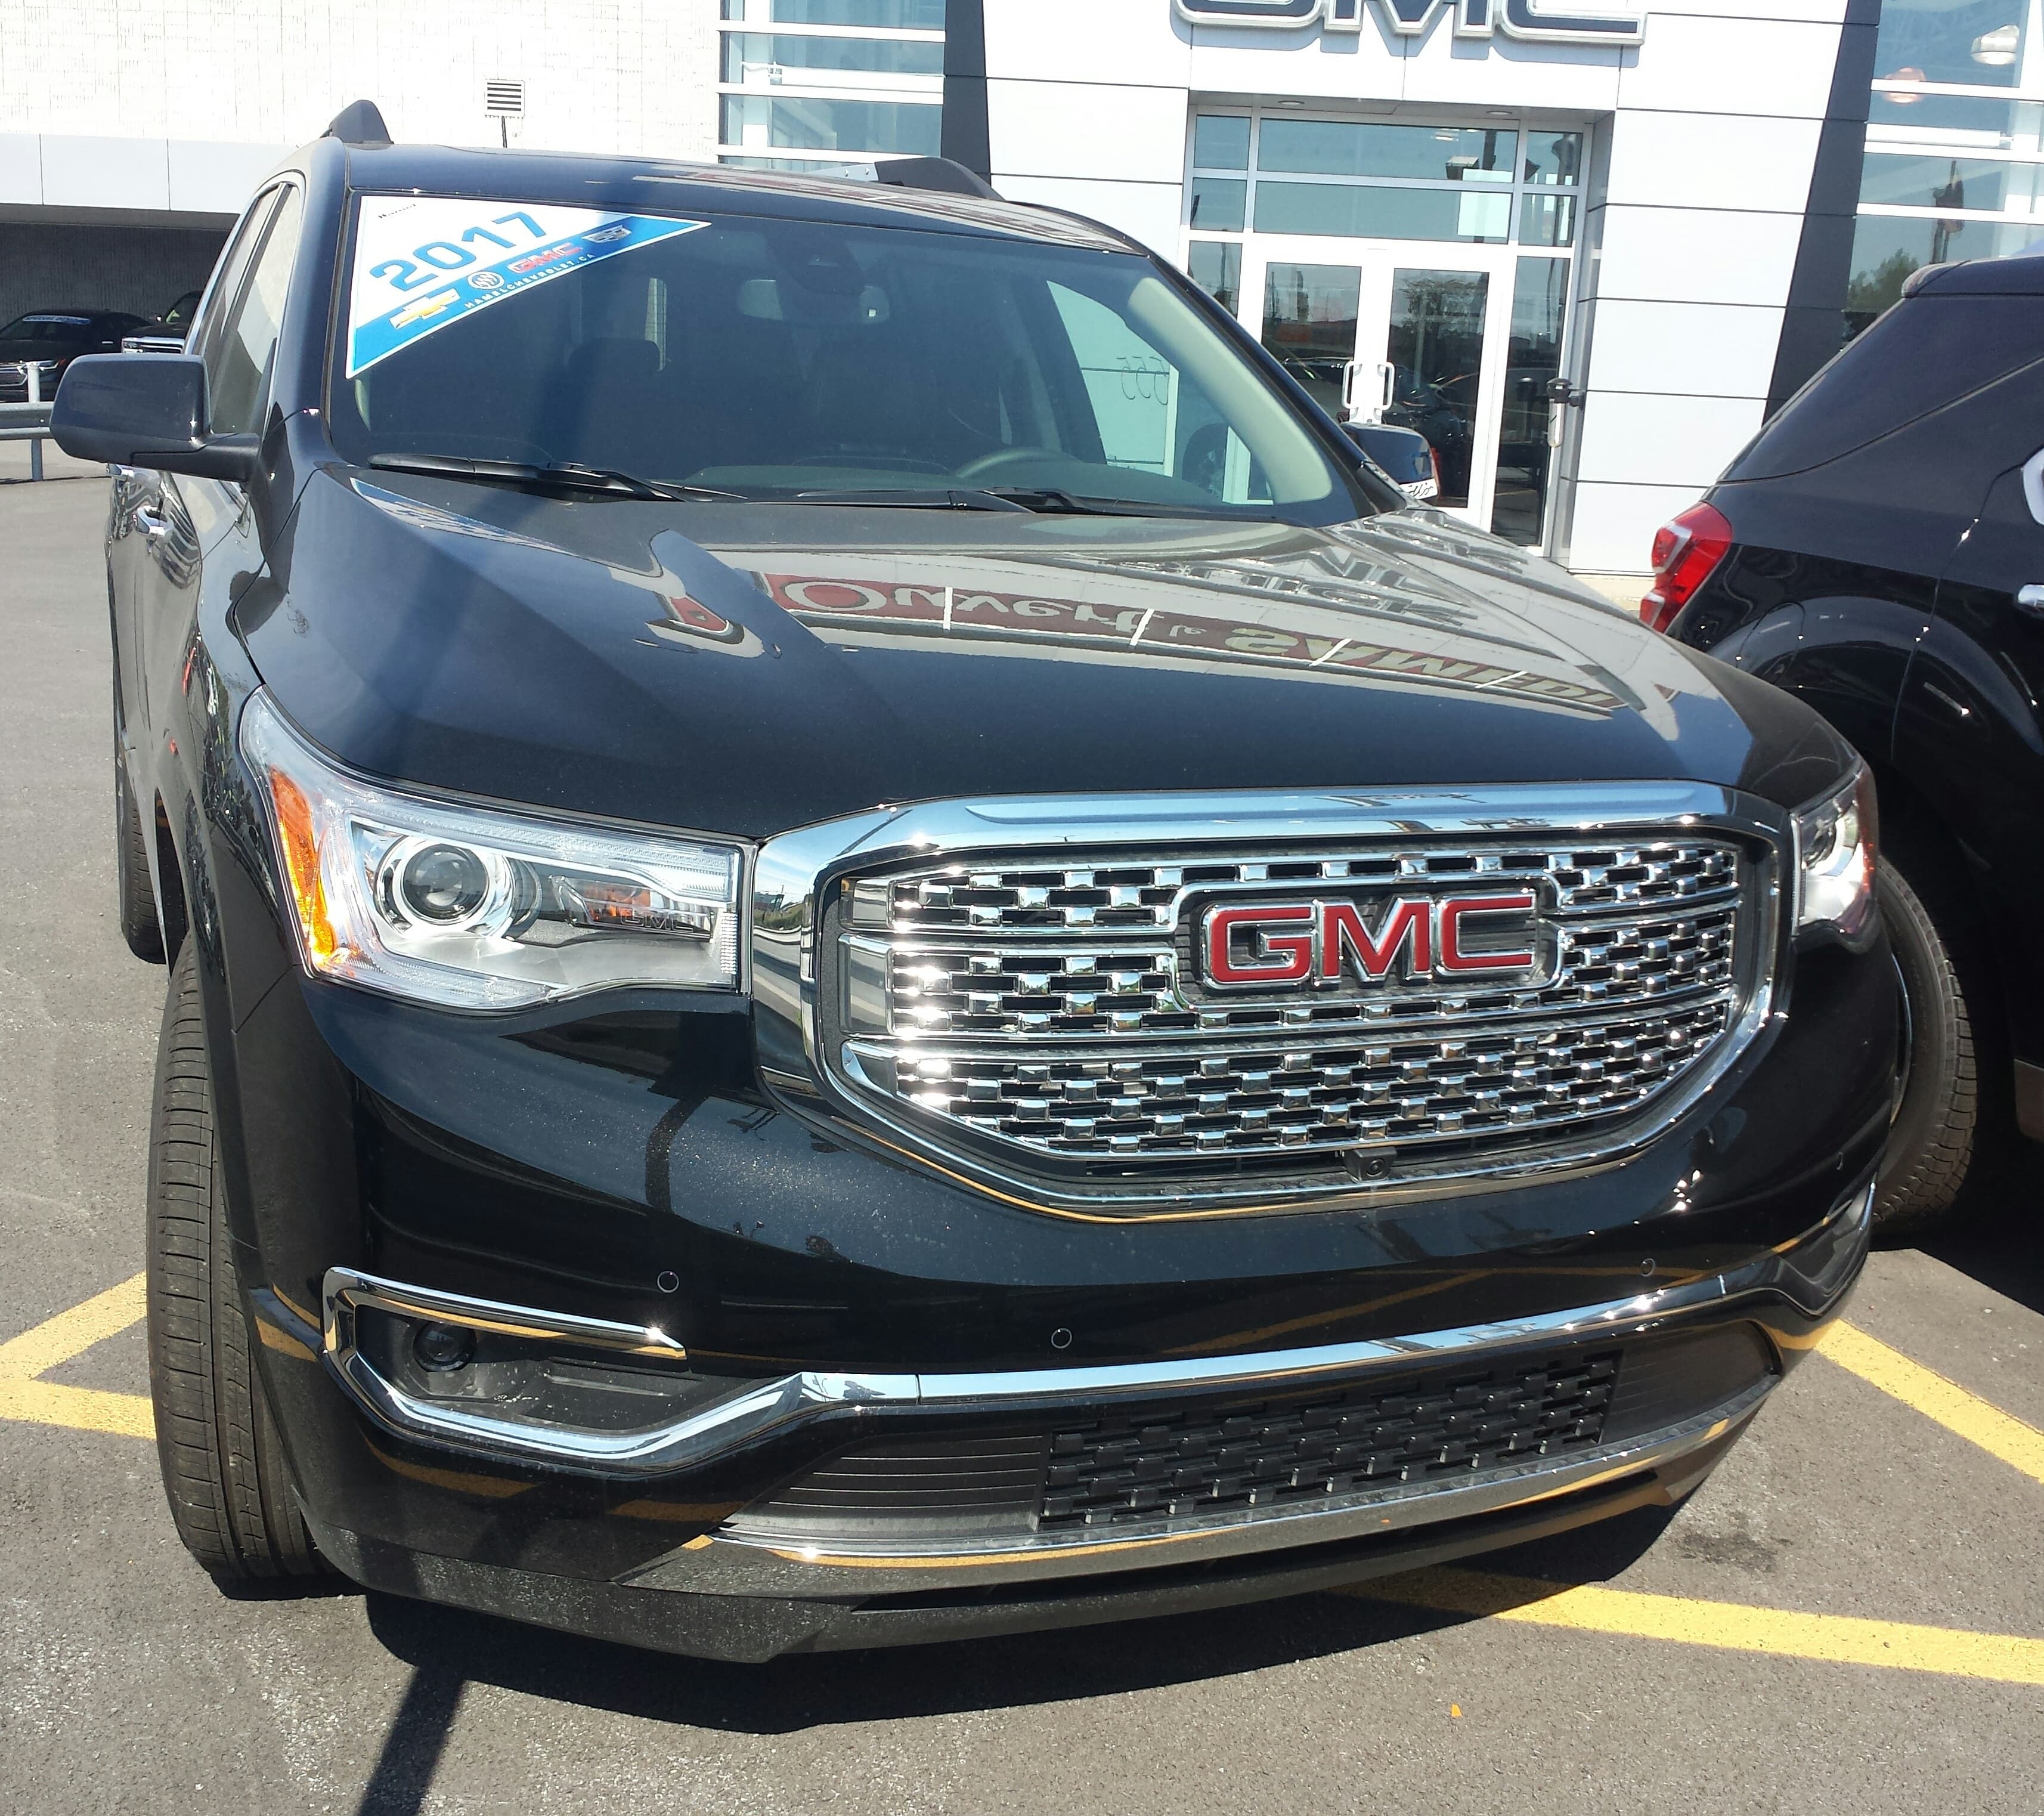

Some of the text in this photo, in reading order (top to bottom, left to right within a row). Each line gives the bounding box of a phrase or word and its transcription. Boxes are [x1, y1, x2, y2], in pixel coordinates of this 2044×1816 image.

[370, 212, 547, 291] 2017
[464, 253, 595, 309] HAMELCHEVROLET.CA
[507, 242, 583, 273] GMC
[1201, 893, 1537, 989] GMC
